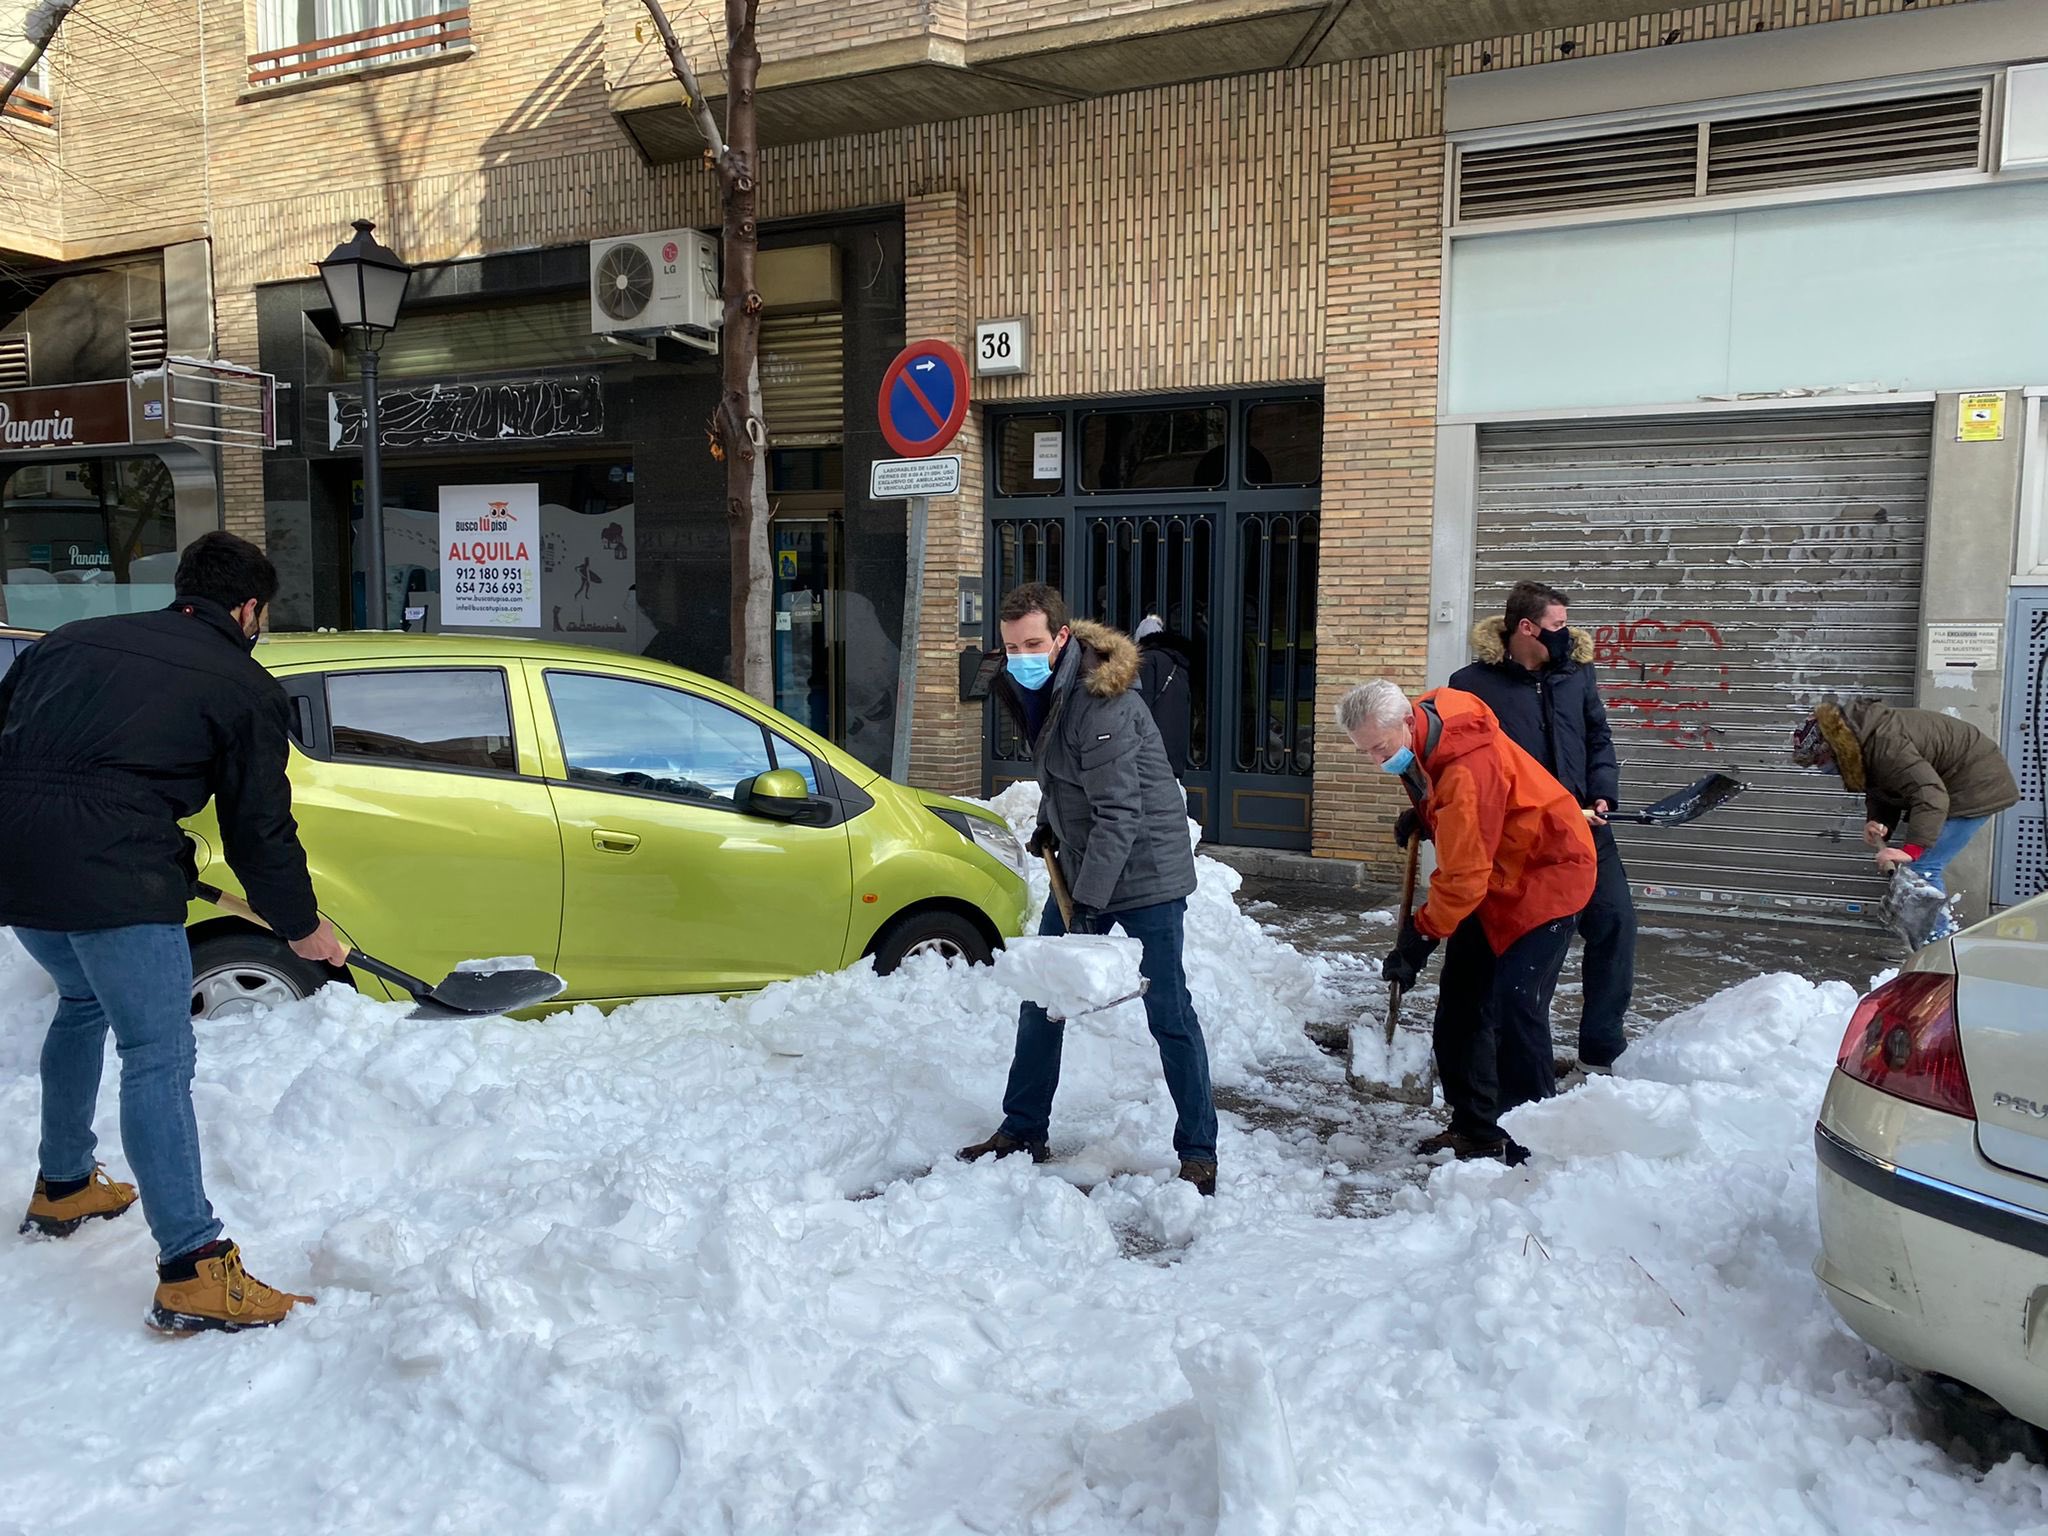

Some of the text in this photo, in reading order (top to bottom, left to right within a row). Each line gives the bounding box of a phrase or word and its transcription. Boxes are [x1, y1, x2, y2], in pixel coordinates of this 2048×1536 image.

[664, 265, 676, 274] LG
[982, 332, 1011, 359] 38
[69, 545, 111, 565] Panaria
[448, 542, 529, 565] ALQUILA
[456, 567, 522, 580] 912 180 951
[455, 582, 523, 594] 654 736 693
[455, 594, 523, 602] www.buscotupiso.com
[1993, 1091, 2048, 1119] PEU
